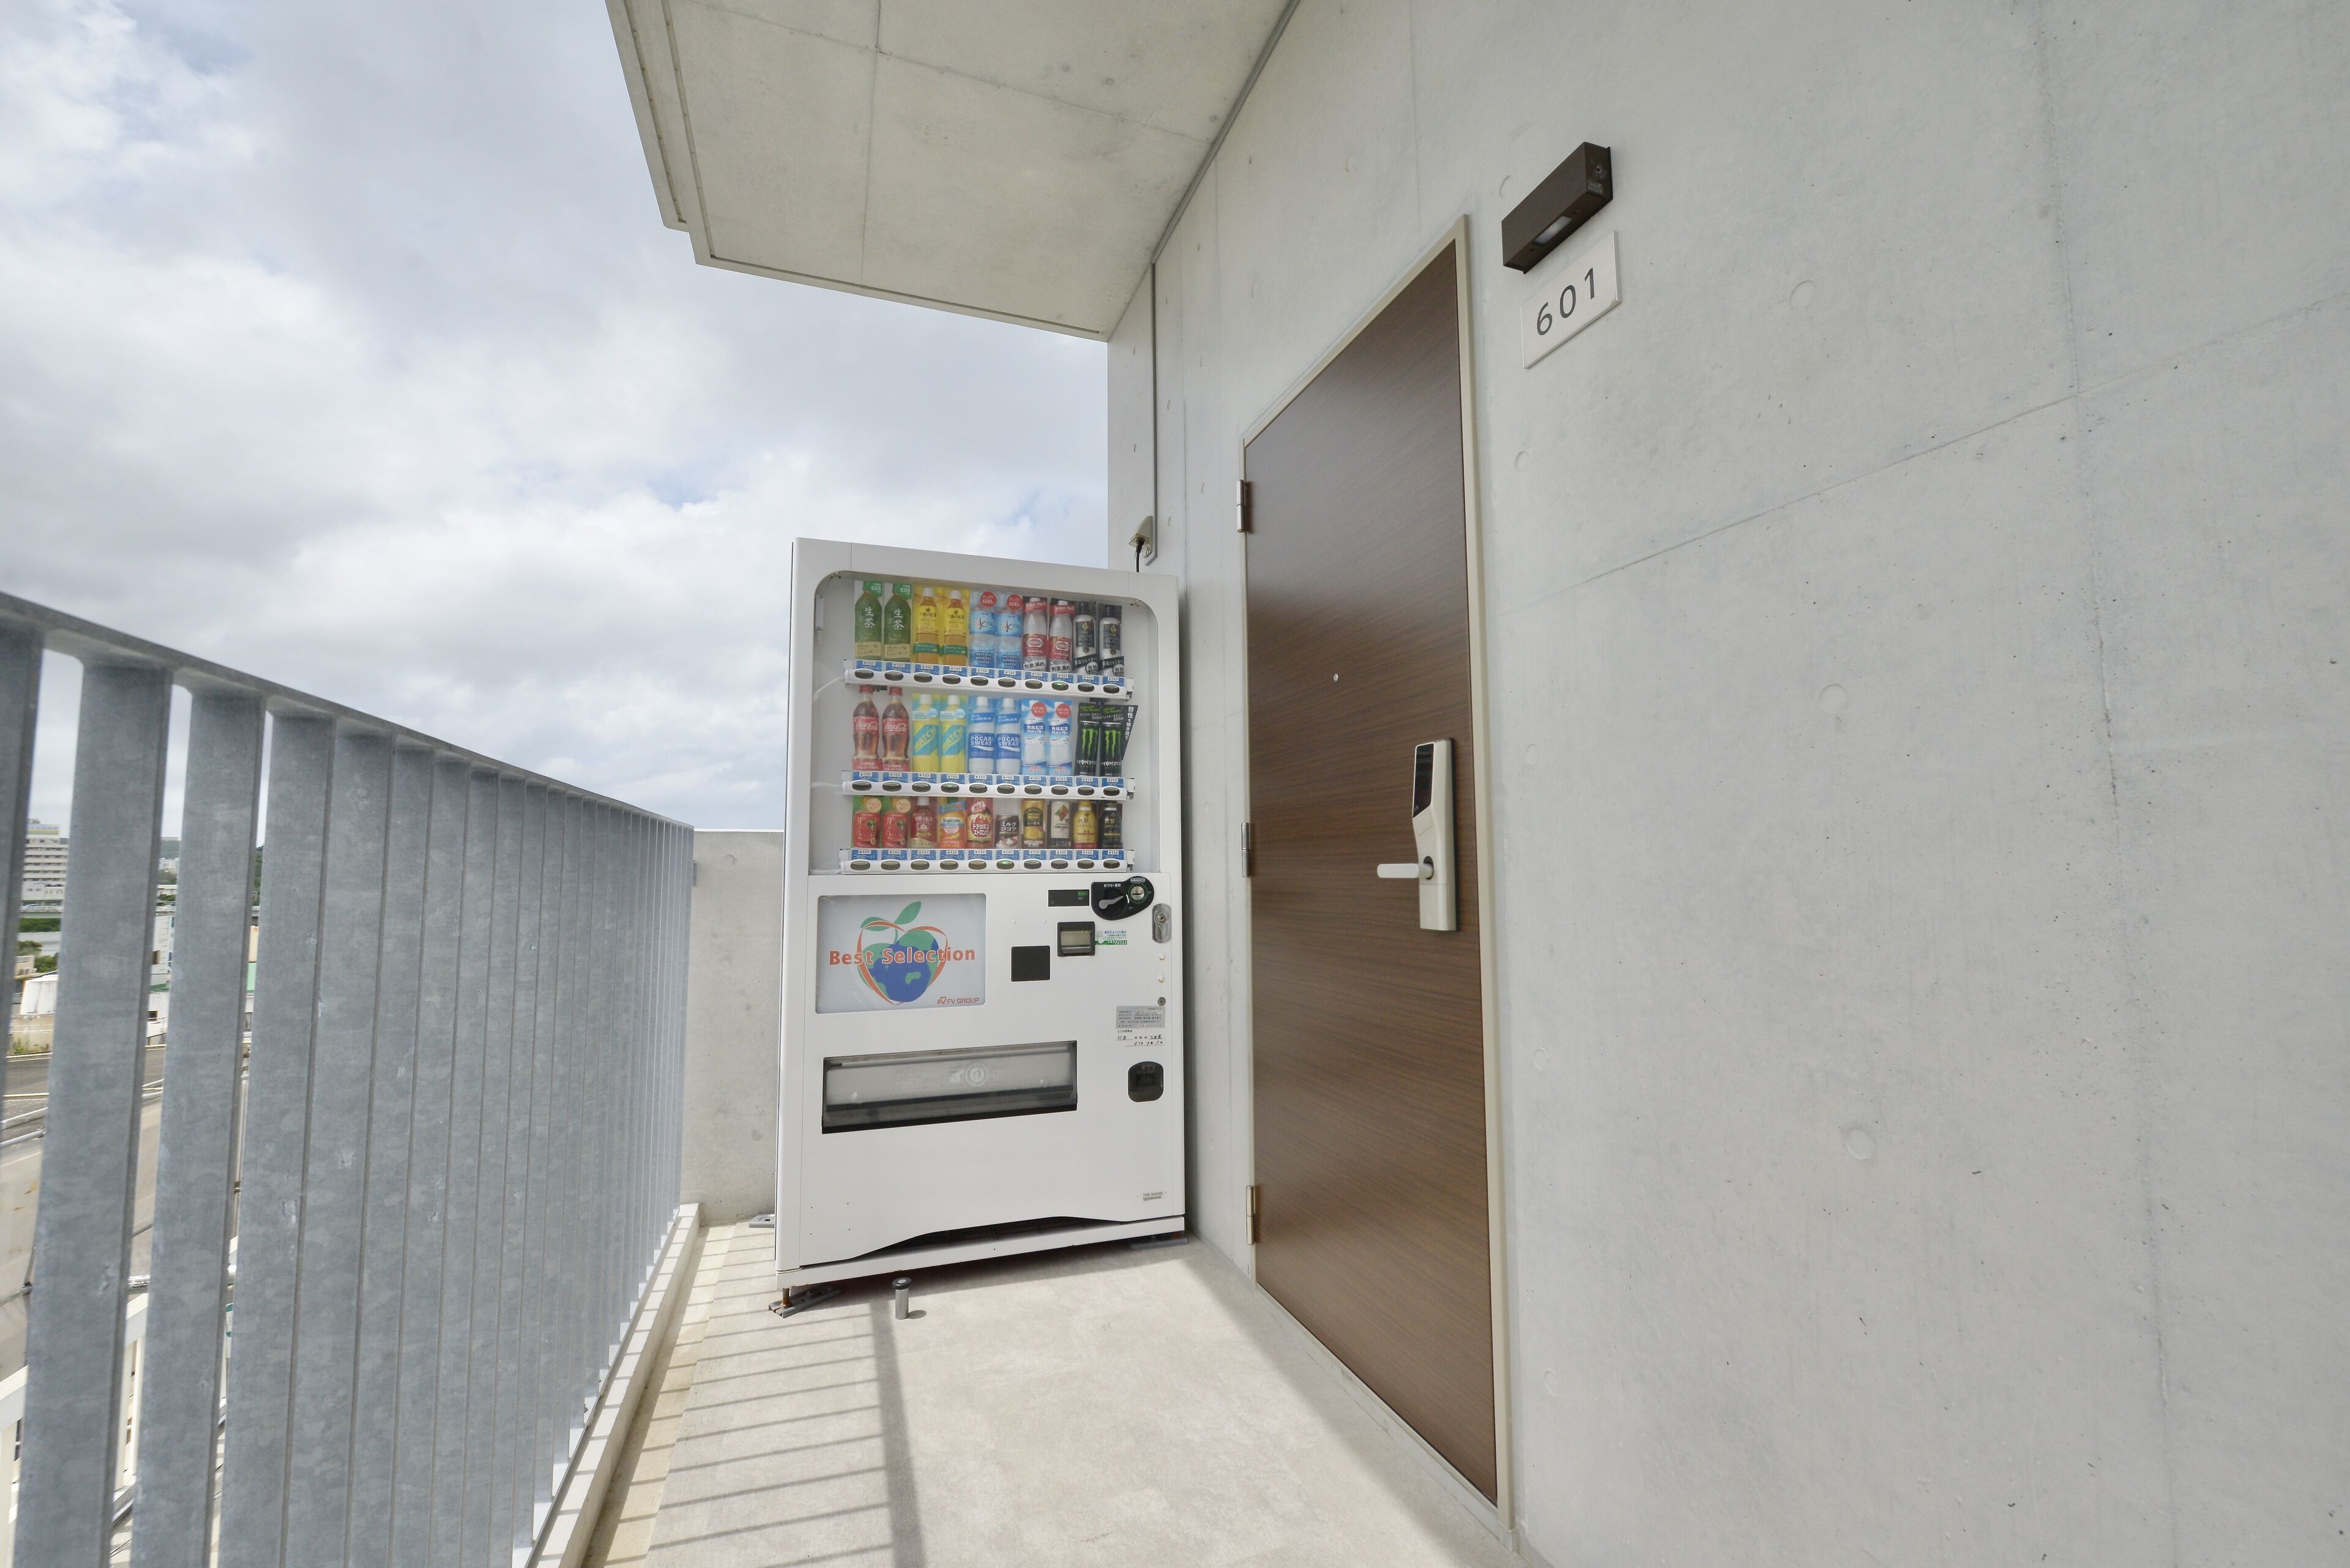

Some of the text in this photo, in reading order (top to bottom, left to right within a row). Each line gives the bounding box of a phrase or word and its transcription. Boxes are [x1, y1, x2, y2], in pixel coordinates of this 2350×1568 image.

[1537, 267, 1595, 336] 601
[864, 607, 875, 628] 生茶
[893, 608, 905, 630] 生茶
[856, 721, 878, 731] Coca-Cola
[884, 723, 907, 732] Coca-Cola
[914, 725, 937, 753] MATCH
[942, 725, 964, 753] MATCH
[829, 947, 975, 965] Best Selection
